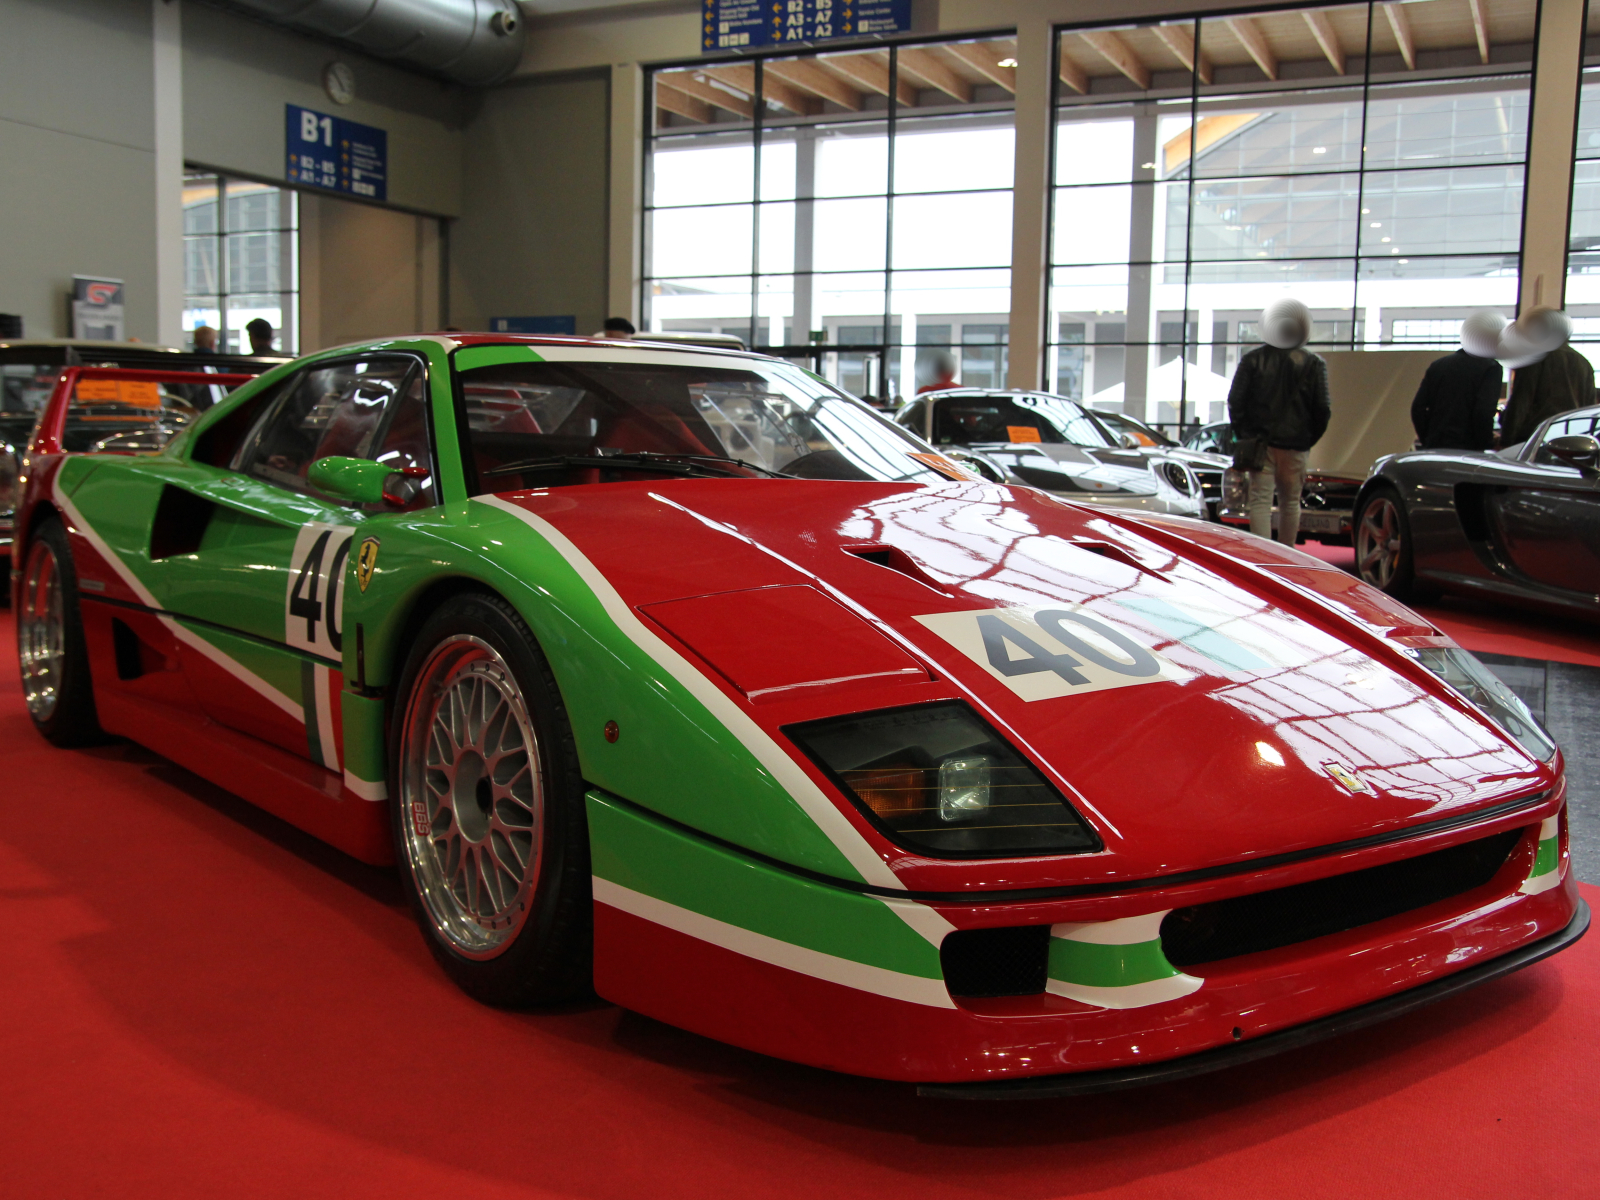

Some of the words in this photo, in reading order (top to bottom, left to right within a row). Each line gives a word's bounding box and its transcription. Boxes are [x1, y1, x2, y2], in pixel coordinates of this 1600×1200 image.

[786, 13, 804, 27] A3
[815, 10, 832, 24] A7
[787, 0, 804, 13] B2
[786, 27, 803, 41] A1
[814, 24, 833, 38] A2
[300, 110, 333, 147] B1
[290, 530, 354, 652] 40
[976, 609, 1161, 686] 40
[413, 802, 429, 834] BBS
